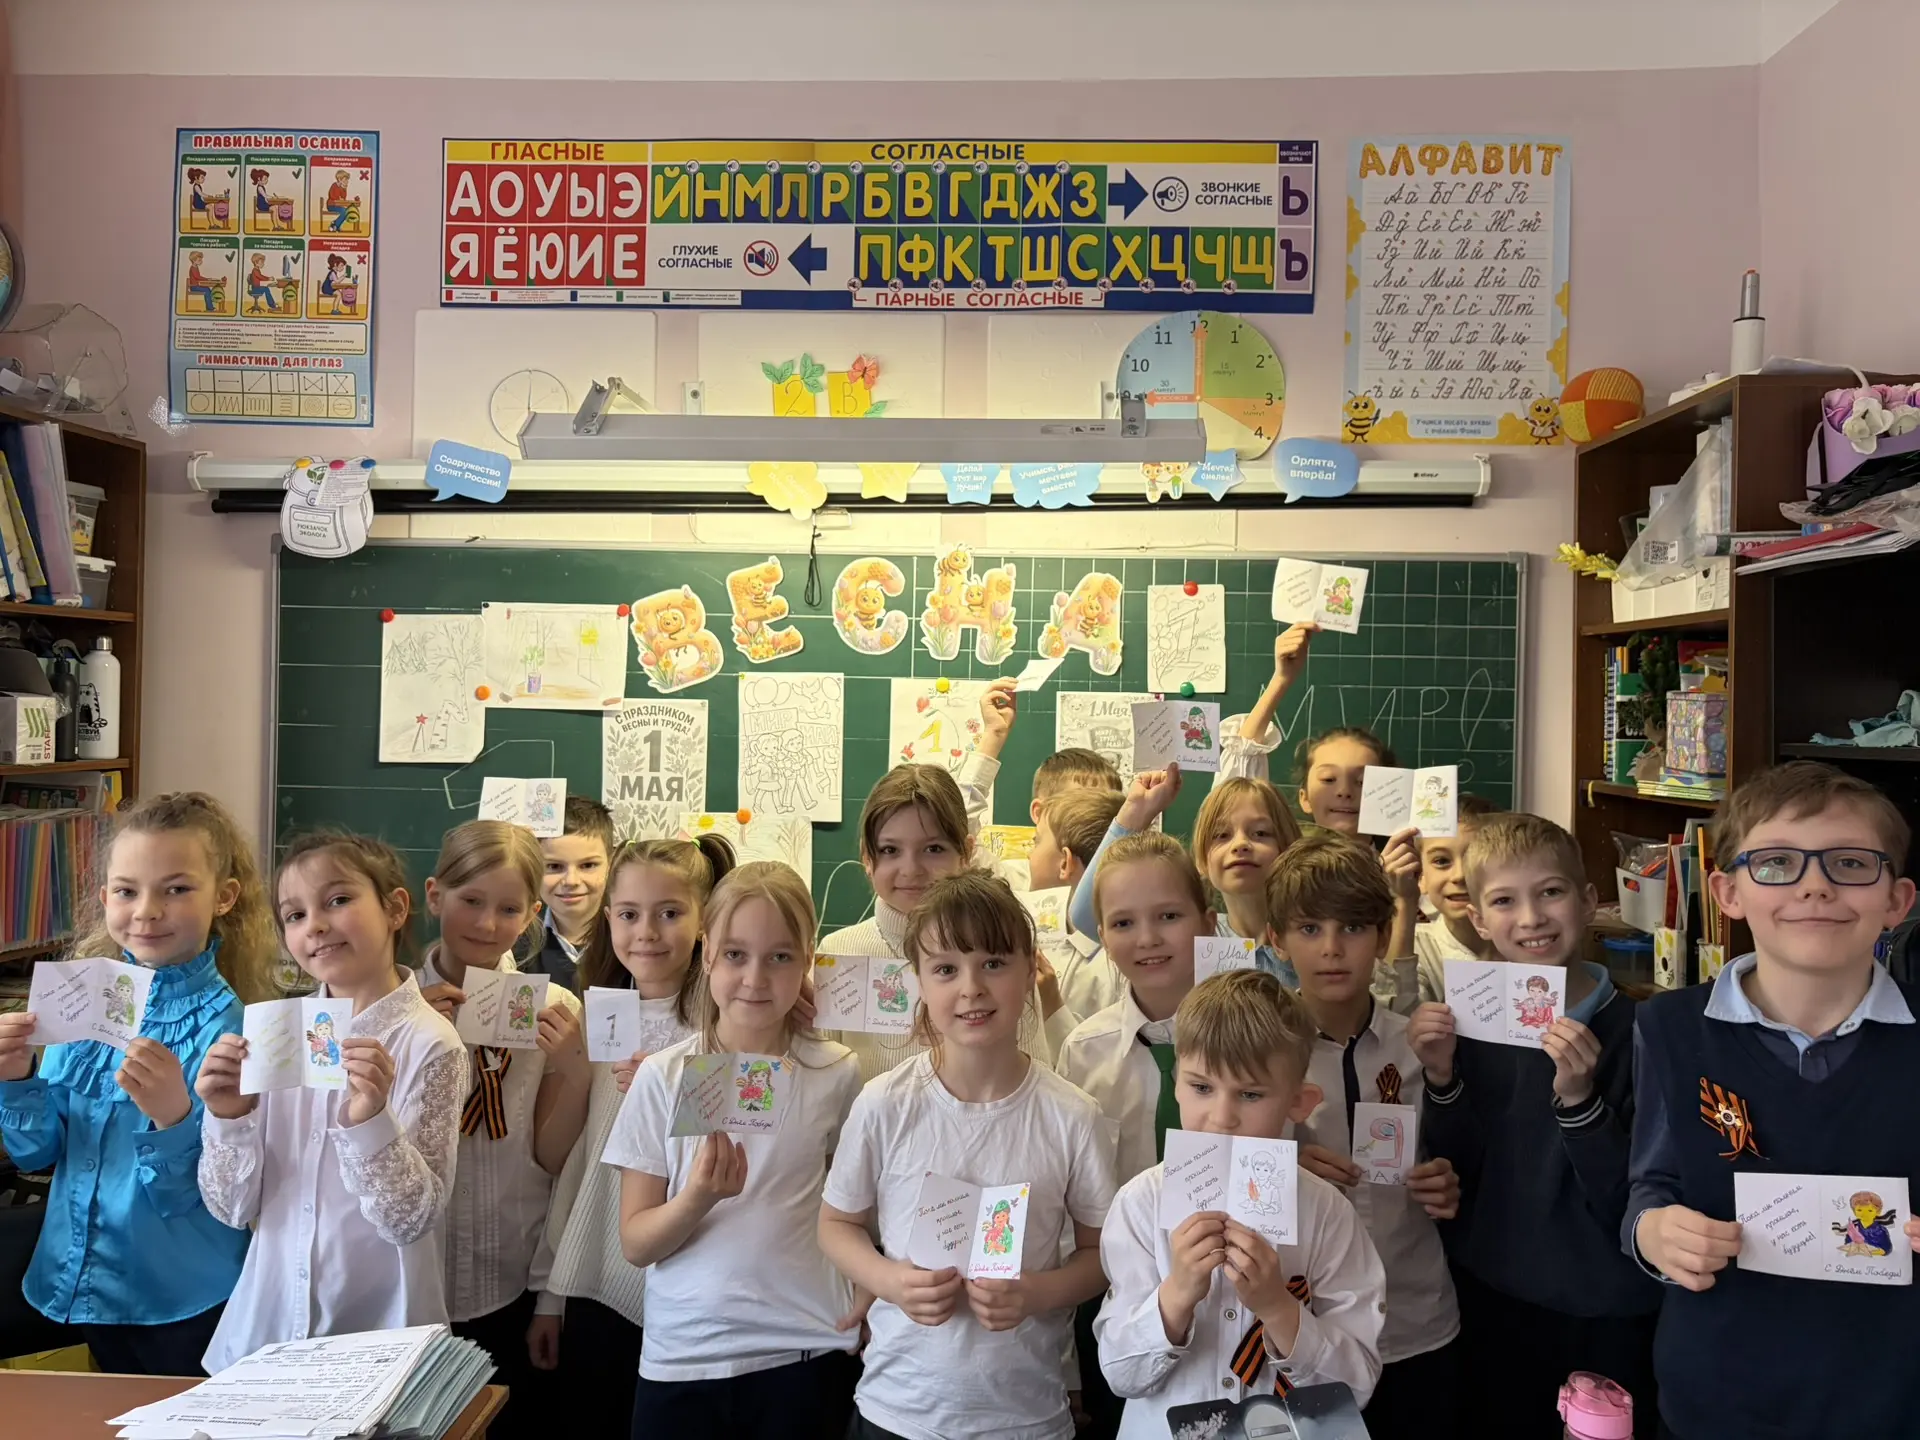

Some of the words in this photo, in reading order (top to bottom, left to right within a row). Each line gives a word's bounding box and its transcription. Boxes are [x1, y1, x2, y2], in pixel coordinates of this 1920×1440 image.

[193, 135, 293, 149] ПРАВИЛЬНАЯ
[299, 136, 362, 150] ОСАНКА
[490, 142, 605, 161] ГЛАСНЫЕ
[870, 143, 1025, 161] СОГЛАСНЫЕ
[1359, 140, 1564, 179] АЛФАВИТ
[1201, 182, 1261, 193] ЗВОНКИЕ
[1195, 194, 1273, 206] СОГЛАСНЫЕ
[672, 245, 719, 256] ГЛУХИЕ
[658, 257, 733, 269] СОГЛАСНЫЕ
[875, 293, 956, 308] ПАРНЫЕ
[966, 292, 1084, 308] СОГЛАСНЫЕ
[1154, 331, 1173, 345] 11
[1230, 330, 1239, 344] 1
[198, 354, 279, 367] ГИМНАСТИКА
[282, 356, 309, 368] ДЛЯ
[313, 357, 343, 368] ГЛАЗ
[1131, 358, 1150, 373] 10
[1255, 354, 1265, 369] 2
[1265, 392, 1274, 406] 3
[1254, 426, 1264, 439] 4
[439, 454, 501, 478] Содружество
[1291, 455, 1337, 470] Орлята,
[434, 464, 463, 480] Орлят
[464, 470, 502, 488] России!
[1290, 468, 1336, 481] вперёд!
[615, 714, 624, 724] С
[623, 705, 695, 726] ПРАЗДНИКОМ
[621, 718, 651, 732] ВЕСНЫ
[661, 719, 691, 735] ТРУДА!
[643, 730, 662, 773] 1
[620, 775, 684, 802] МАЯ
[1824, 1263, 1832, 1272] С
